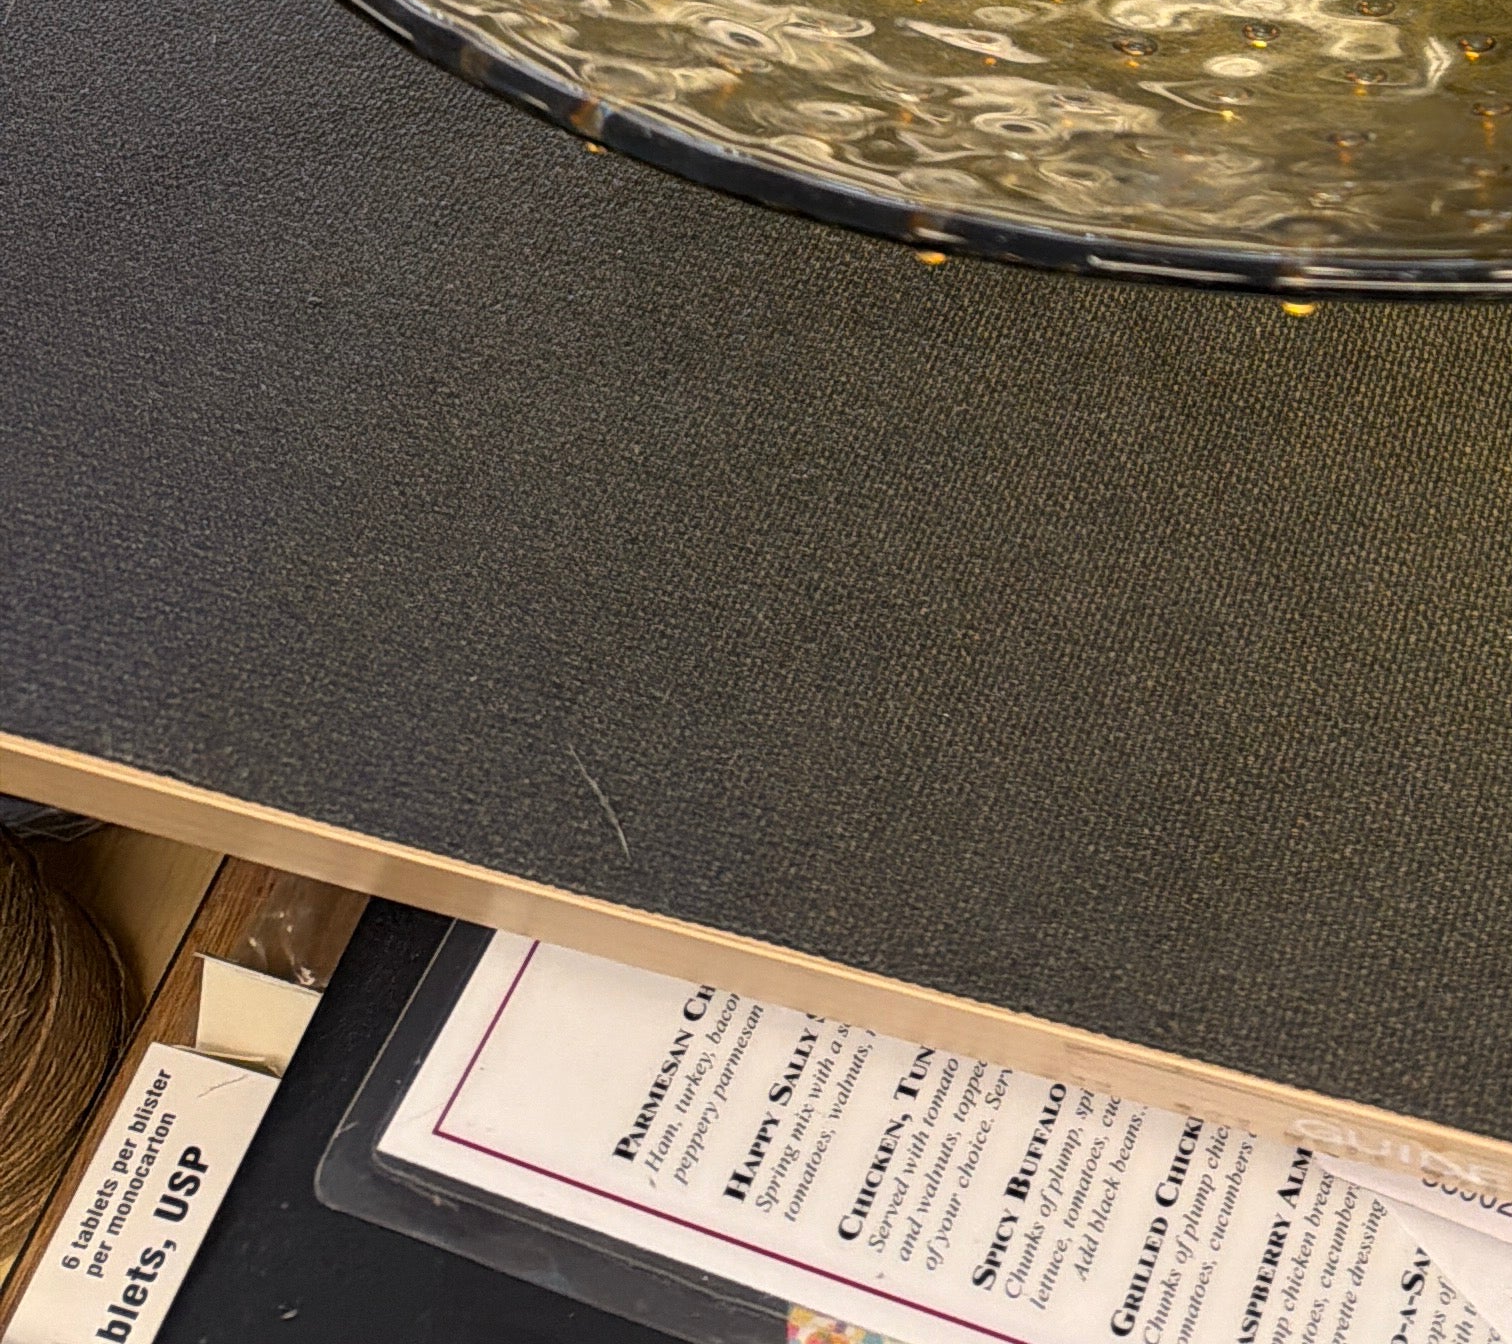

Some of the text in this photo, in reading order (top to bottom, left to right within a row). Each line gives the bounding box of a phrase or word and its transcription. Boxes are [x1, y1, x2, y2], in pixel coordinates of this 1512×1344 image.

[612, 1029, 695, 1162] PARMESAN
[645, 1122, 683, 1172] Ham,
[674, 1052, 716, 1113] turkey,
[674, 1004, 764, 1185] peppery parmesan
[723, 1111, 780, 1202] HAPPY
[768, 1027, 819, 1107] SALLY
[756, 1145, 800, 1212] Spring
[791, 1103, 815, 1141] mix
[808, 1057, 835, 1099] with
[830, 1040, 842, 1054] a
[784, 1044, 873, 1222] tomatoes, walnuts,
[869, 1058, 959, 1253] Served with tomato
[62, 1069, 172, 1270] 6 tablets per blister
[87, 1112, 176, 1278] per monocarton
[153, 1146, 209, 1222] USP
[838, 1113, 913, 1241] CHICKEN,
[901, 1216, 923, 1262] and
[917, 1131, 962, 1213] walnuts,
[926, 1244, 945, 1271] of
[936, 1192, 962, 1248] your
[958, 1119, 995, 1189] choice.
[972, 1083, 1067, 1291] SPICY BUFFALO
[1030, 1237, 1073, 1310] lettuce,
[1063, 1136, 1110, 1228] tomatoes,
[1040, 1189, 1058, 1218] of
[1048, 1127, 1084, 1196] plump,
[1182, 1173, 1216, 1242] plump
[1210, 1141, 1253, 1252] cucumbers
[1005, 1221, 1046, 1299] Chunks
[1074, 1233, 1099, 1282] Add
[1088, 1178, 1120, 1233] black
[1110, 1217, 1168, 1337] GRILLED
[1176, 1235, 1193, 1264] of
[1281, 1231, 1317, 1312] chicken
[1347, 1198, 1388, 1287] dressing
[1144, 1268, 1182, 1344] Chunks
